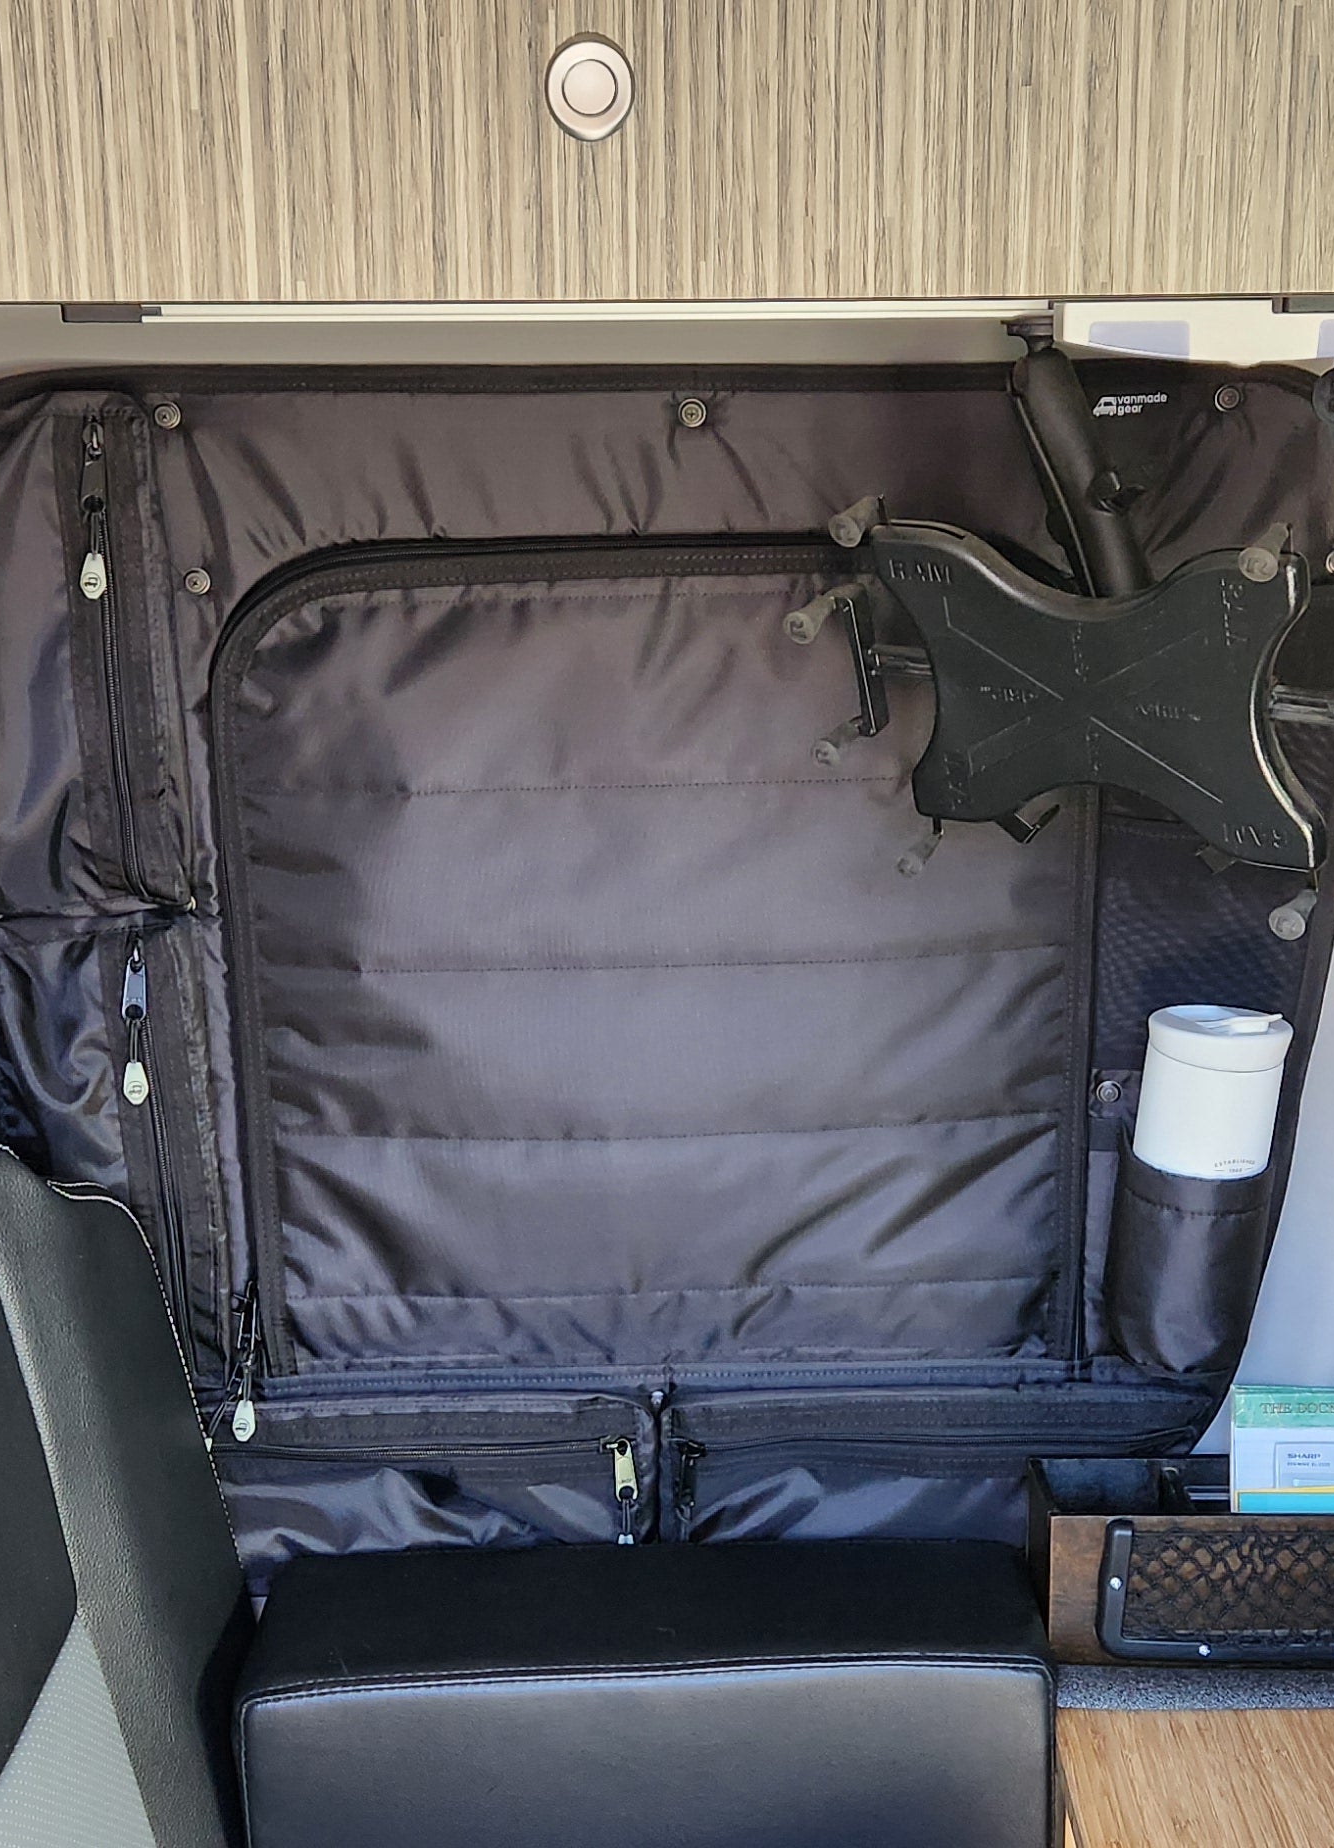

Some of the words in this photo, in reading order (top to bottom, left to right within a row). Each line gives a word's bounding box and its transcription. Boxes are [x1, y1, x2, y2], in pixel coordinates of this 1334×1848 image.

[1117, 391, 1168, 405] vanmade
[1117, 404, 1143, 416] gear
[1259, 1402, 1293, 1414] THE
